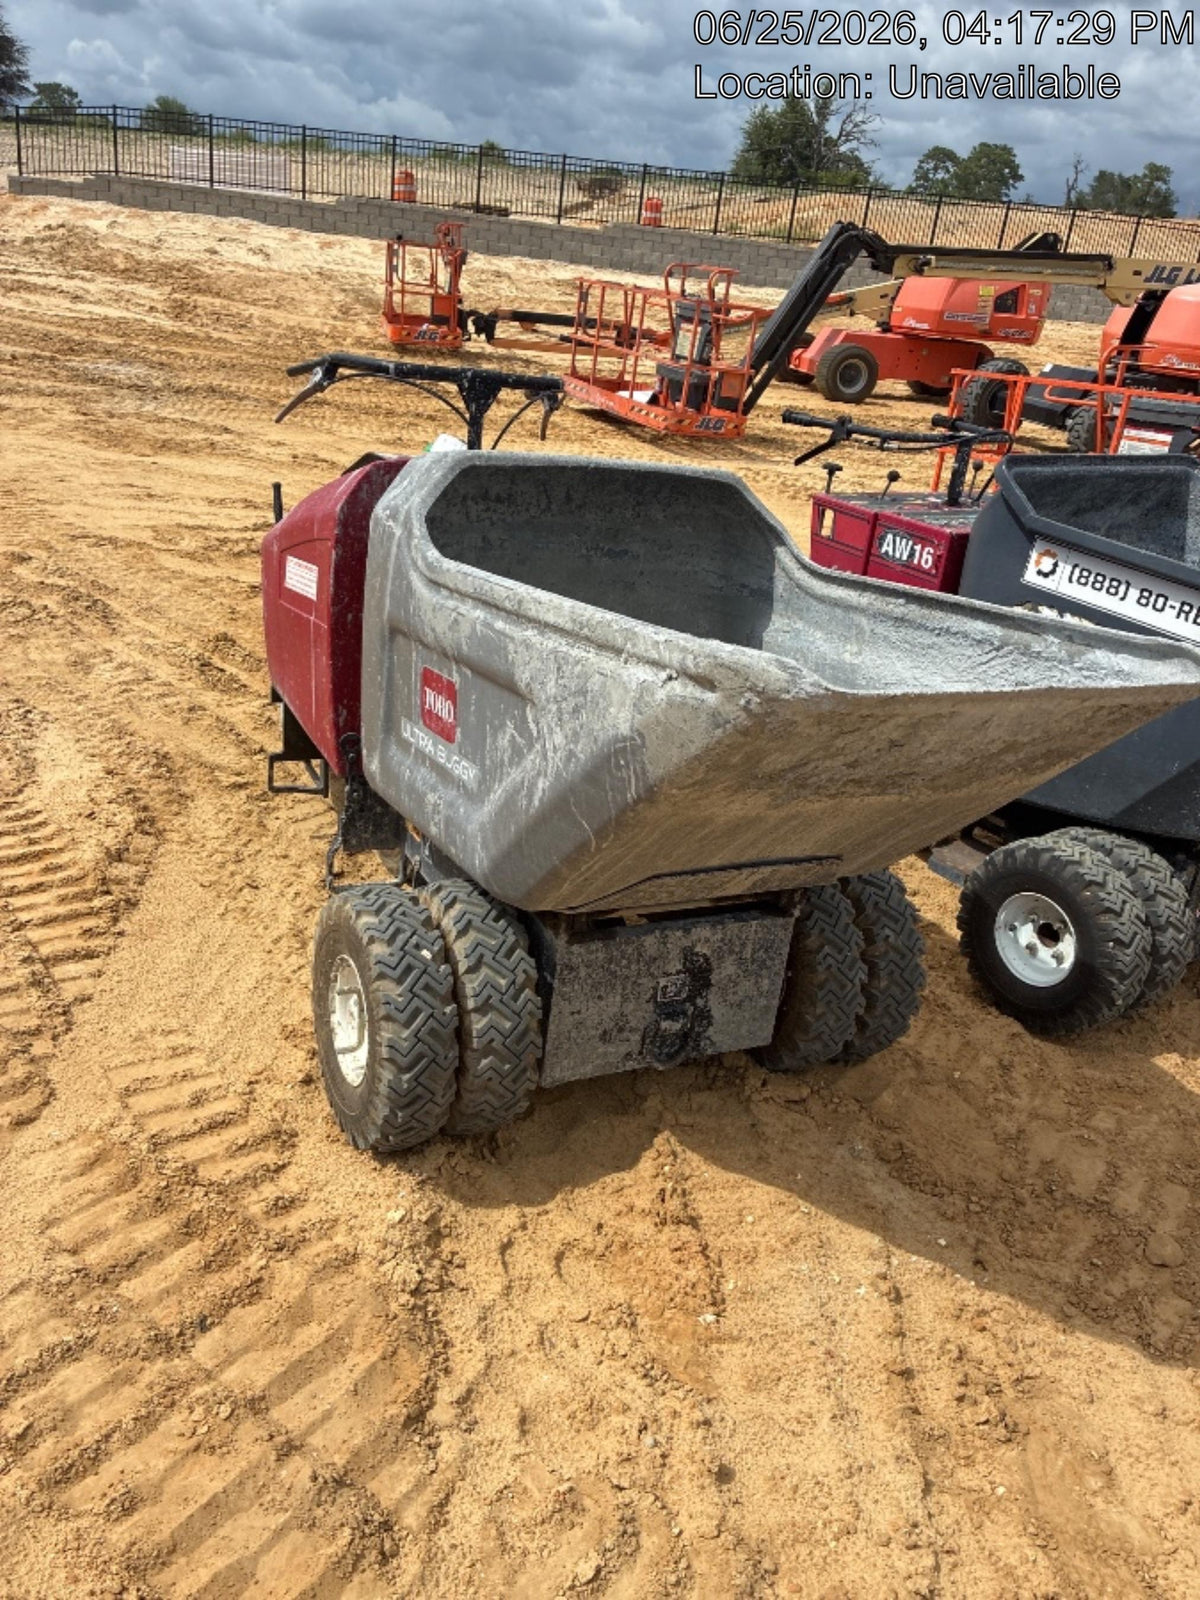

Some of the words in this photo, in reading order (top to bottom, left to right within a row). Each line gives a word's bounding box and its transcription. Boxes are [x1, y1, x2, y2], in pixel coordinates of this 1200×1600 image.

[1143, 265, 1183, 285] JLG
[881, 533, 934, 570] AW16
[1068, 563, 1132, 602] (888)
[424, 686, 454, 723] TORO
